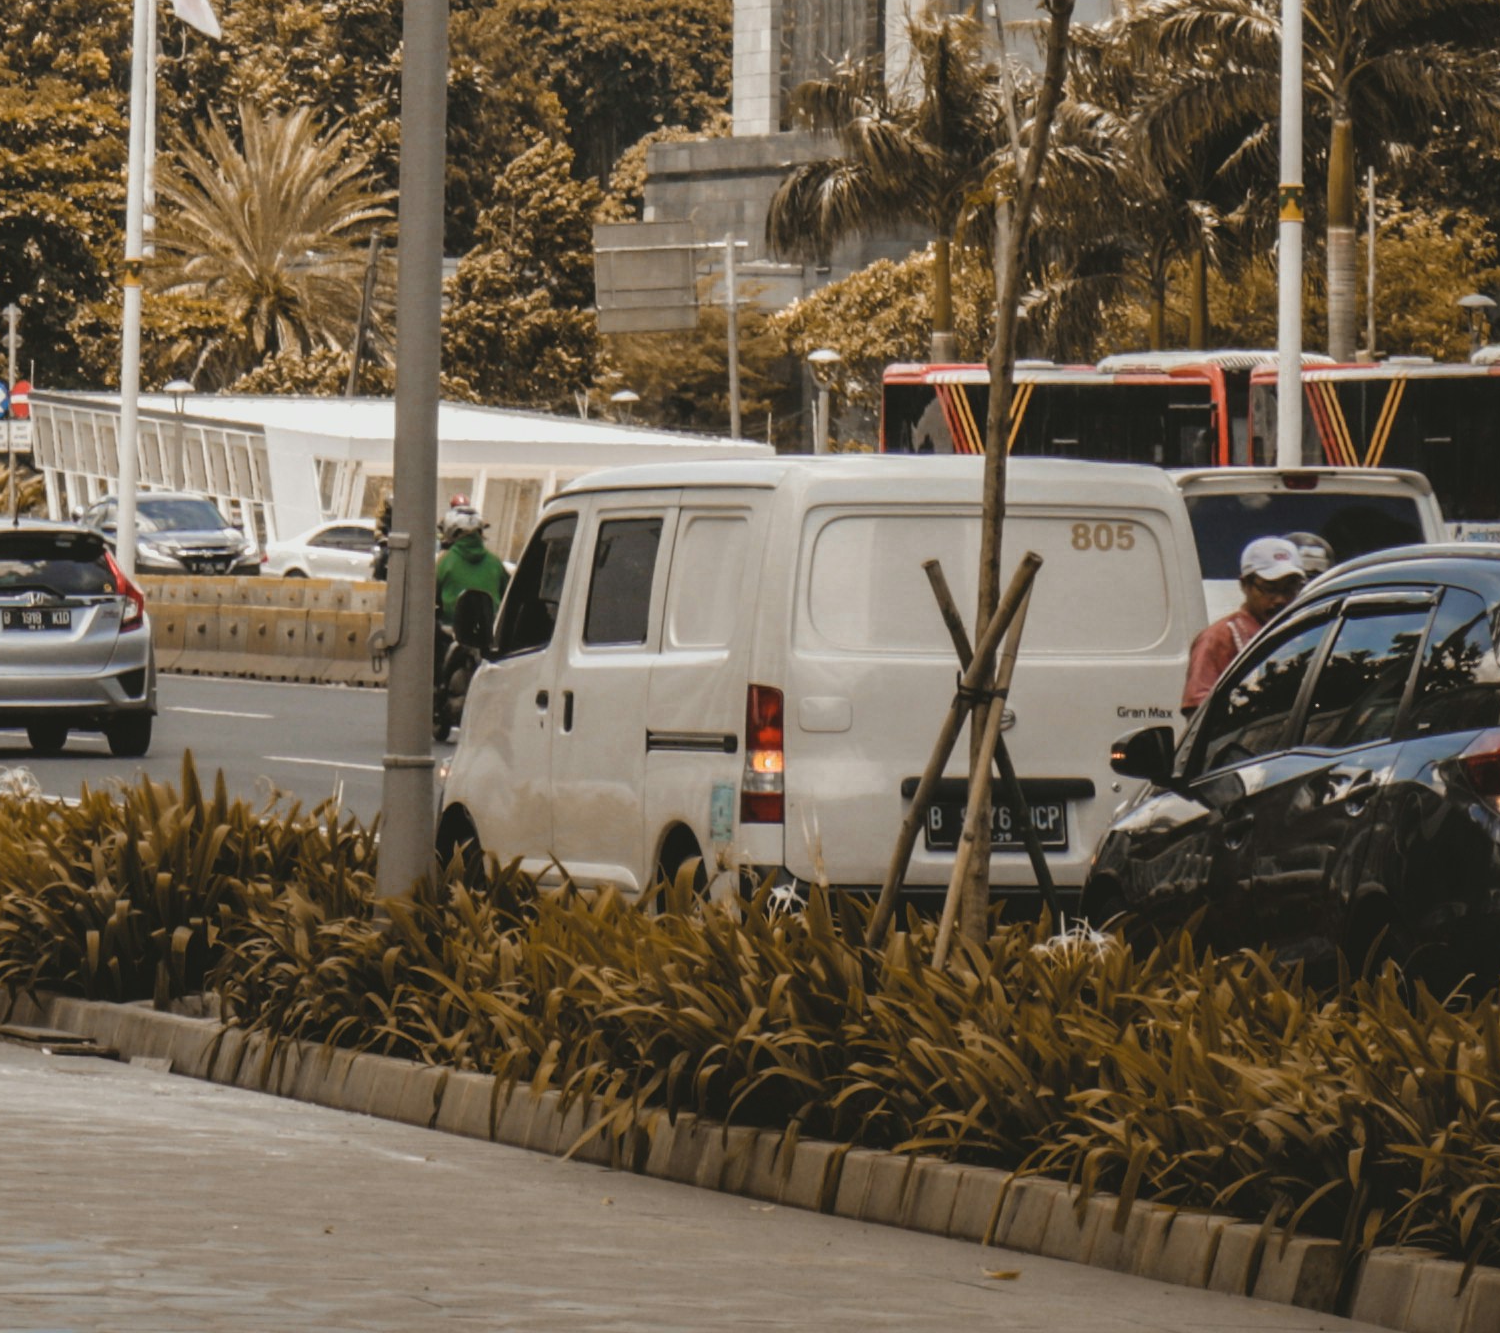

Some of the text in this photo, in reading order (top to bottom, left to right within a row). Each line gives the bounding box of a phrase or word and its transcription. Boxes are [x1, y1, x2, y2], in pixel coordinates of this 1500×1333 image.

[1071, 523, 1135, 551] 805
[1117, 706, 1173, 718] Gran Max
[930, 806, 942, 830] B
